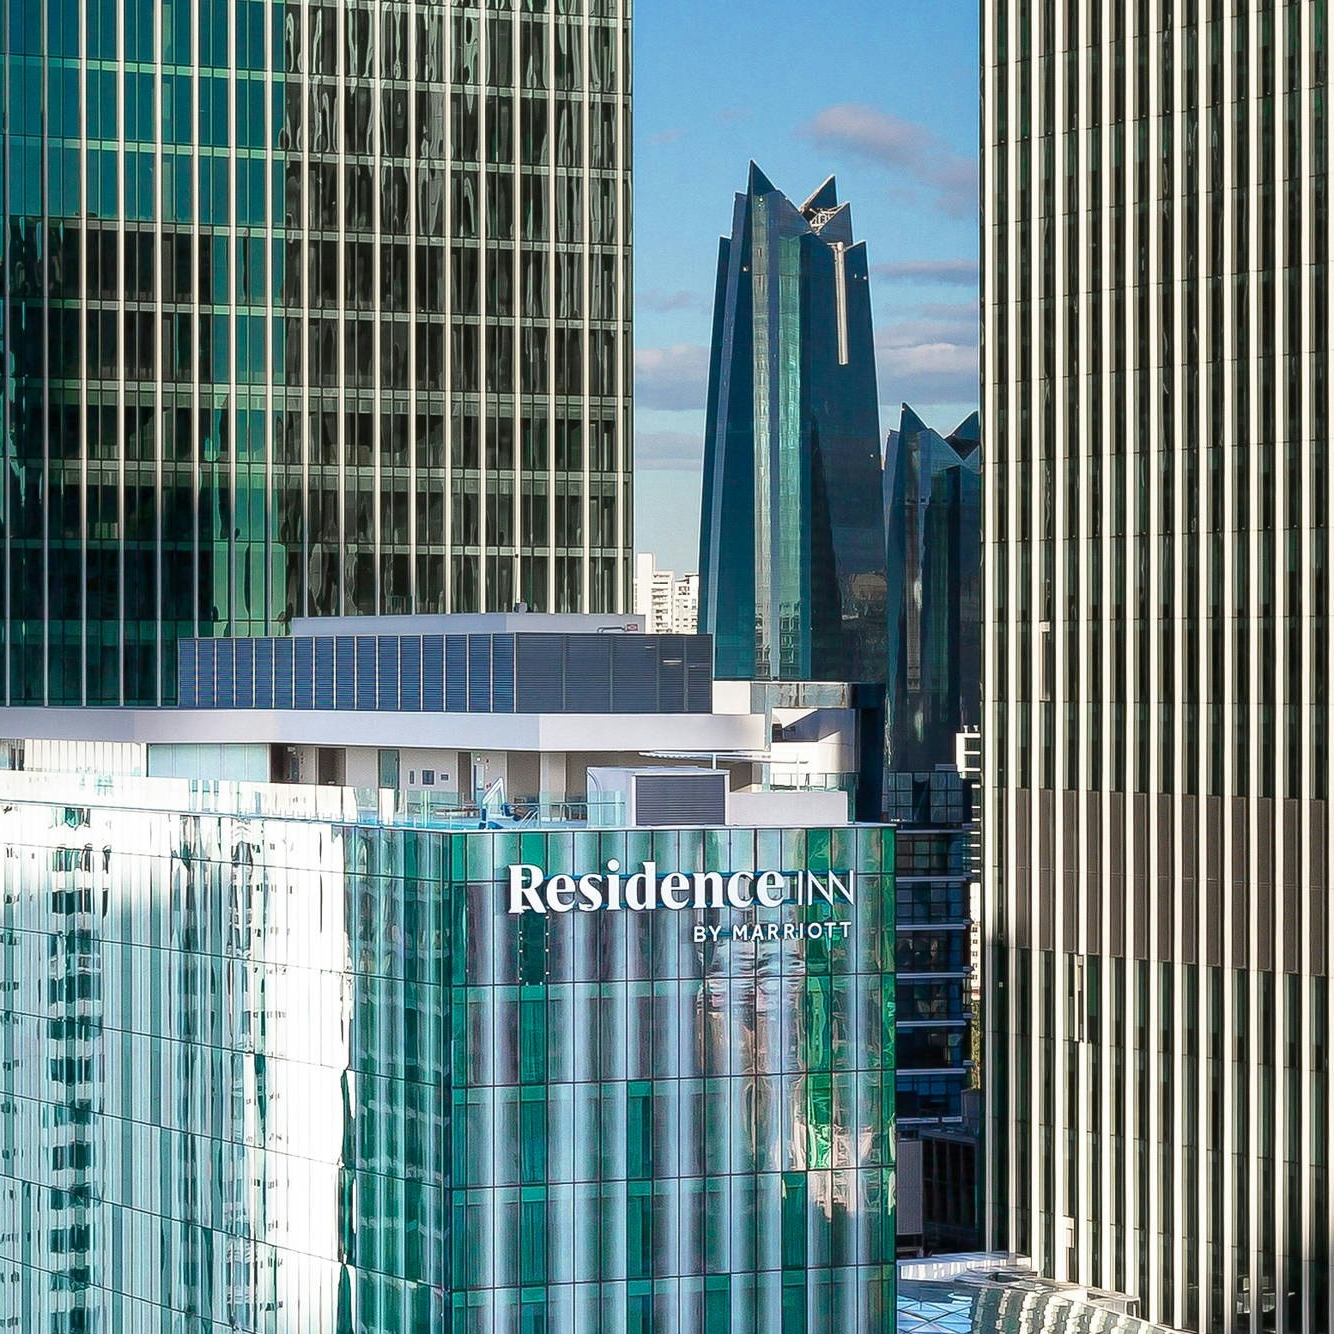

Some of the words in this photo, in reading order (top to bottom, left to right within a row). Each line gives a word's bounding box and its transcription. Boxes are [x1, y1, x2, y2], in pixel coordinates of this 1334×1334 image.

[508, 858, 784, 915] Residence
[797, 870, 855, 906] INN
[693, 923, 722, 943] BY
[732, 921, 852, 942] MARRIOTT
